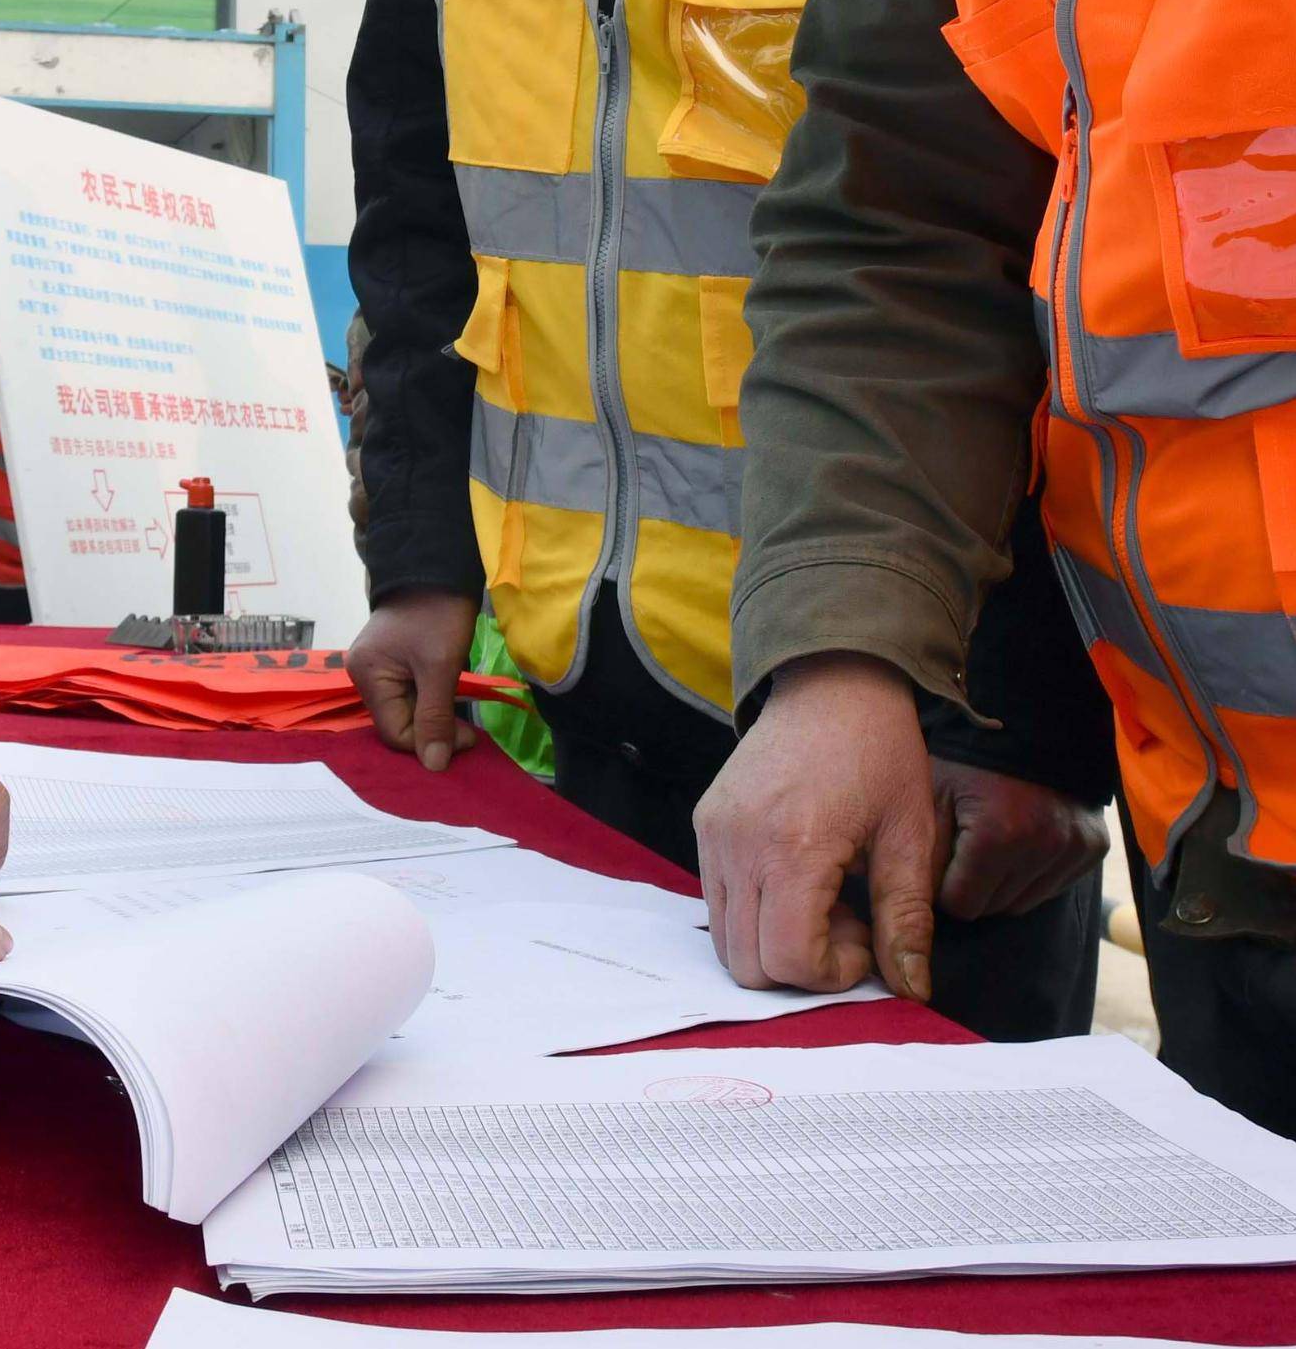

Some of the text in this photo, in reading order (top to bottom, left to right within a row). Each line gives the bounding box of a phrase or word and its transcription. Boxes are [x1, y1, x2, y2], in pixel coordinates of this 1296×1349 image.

[81, 168, 217, 230] 农民工维权须知
[56, 384, 309, 433] 我公司郑重承诺绝不拖欠农民工工资
